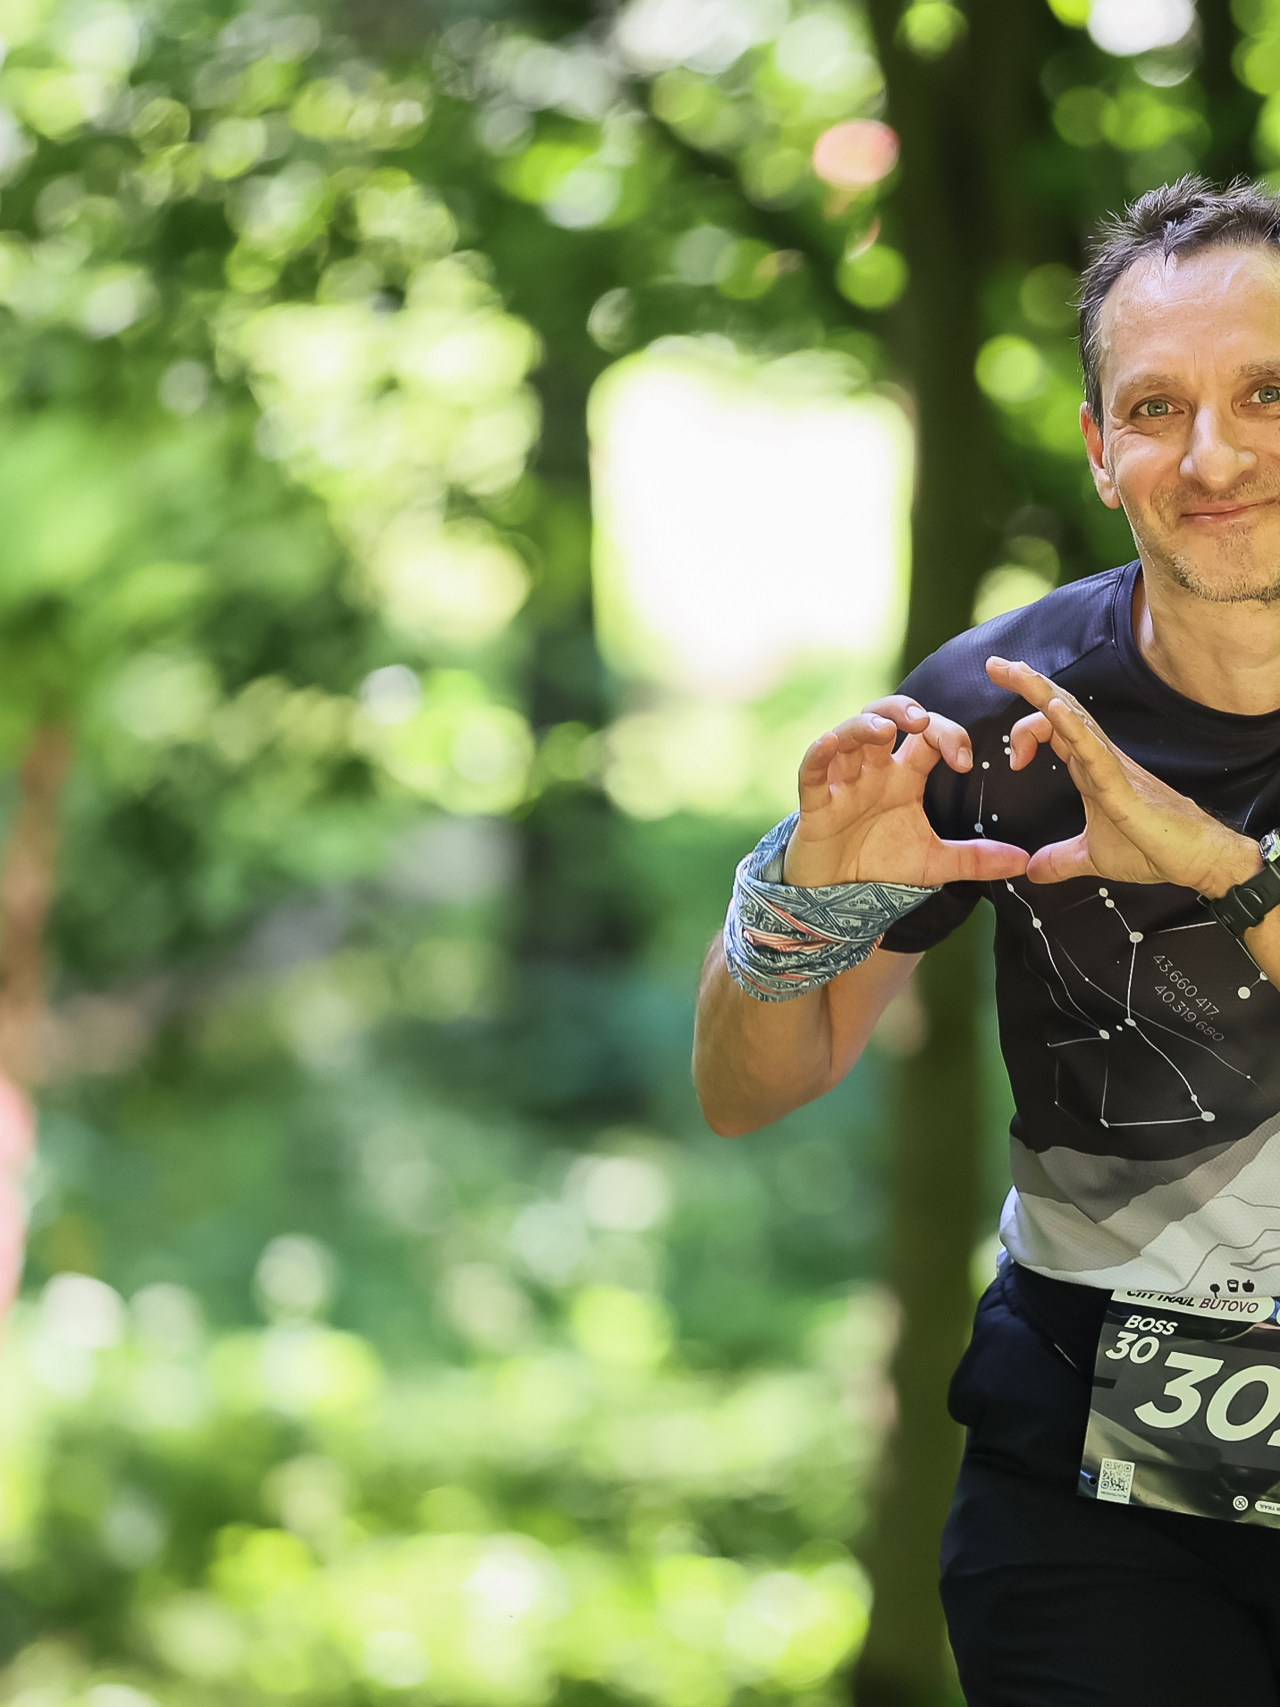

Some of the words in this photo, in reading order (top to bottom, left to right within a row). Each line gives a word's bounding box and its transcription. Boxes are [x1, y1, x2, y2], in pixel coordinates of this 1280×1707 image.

[1153, 955, 1198, 997] 43.660
[1154, 985, 1197, 1023] 40.319
[1199, 1298, 1259, 1314] BUTOVO
[1124, 1314, 1179, 1336] BOSS
[1105, 1330, 1160, 1364] 30
